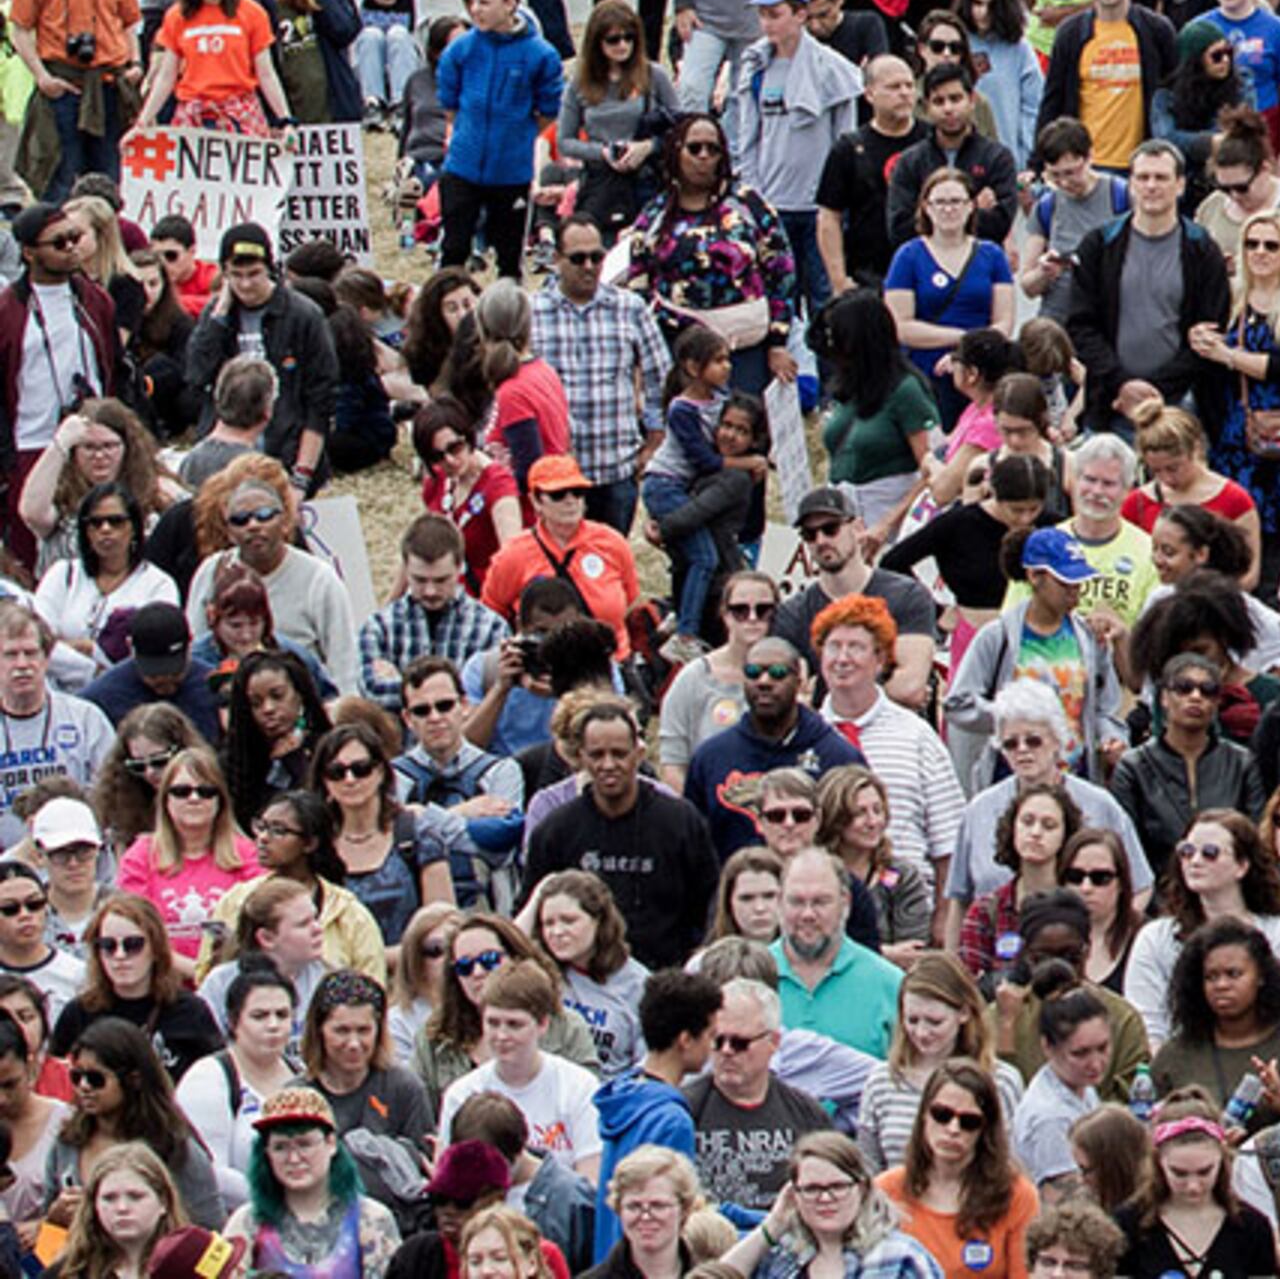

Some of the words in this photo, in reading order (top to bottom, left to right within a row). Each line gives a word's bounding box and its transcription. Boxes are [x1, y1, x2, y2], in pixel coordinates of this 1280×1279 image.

[122, 131, 285, 187] #NEVER
[334, 159, 360, 192] IS
[138, 186, 257, 229] AGAIN
